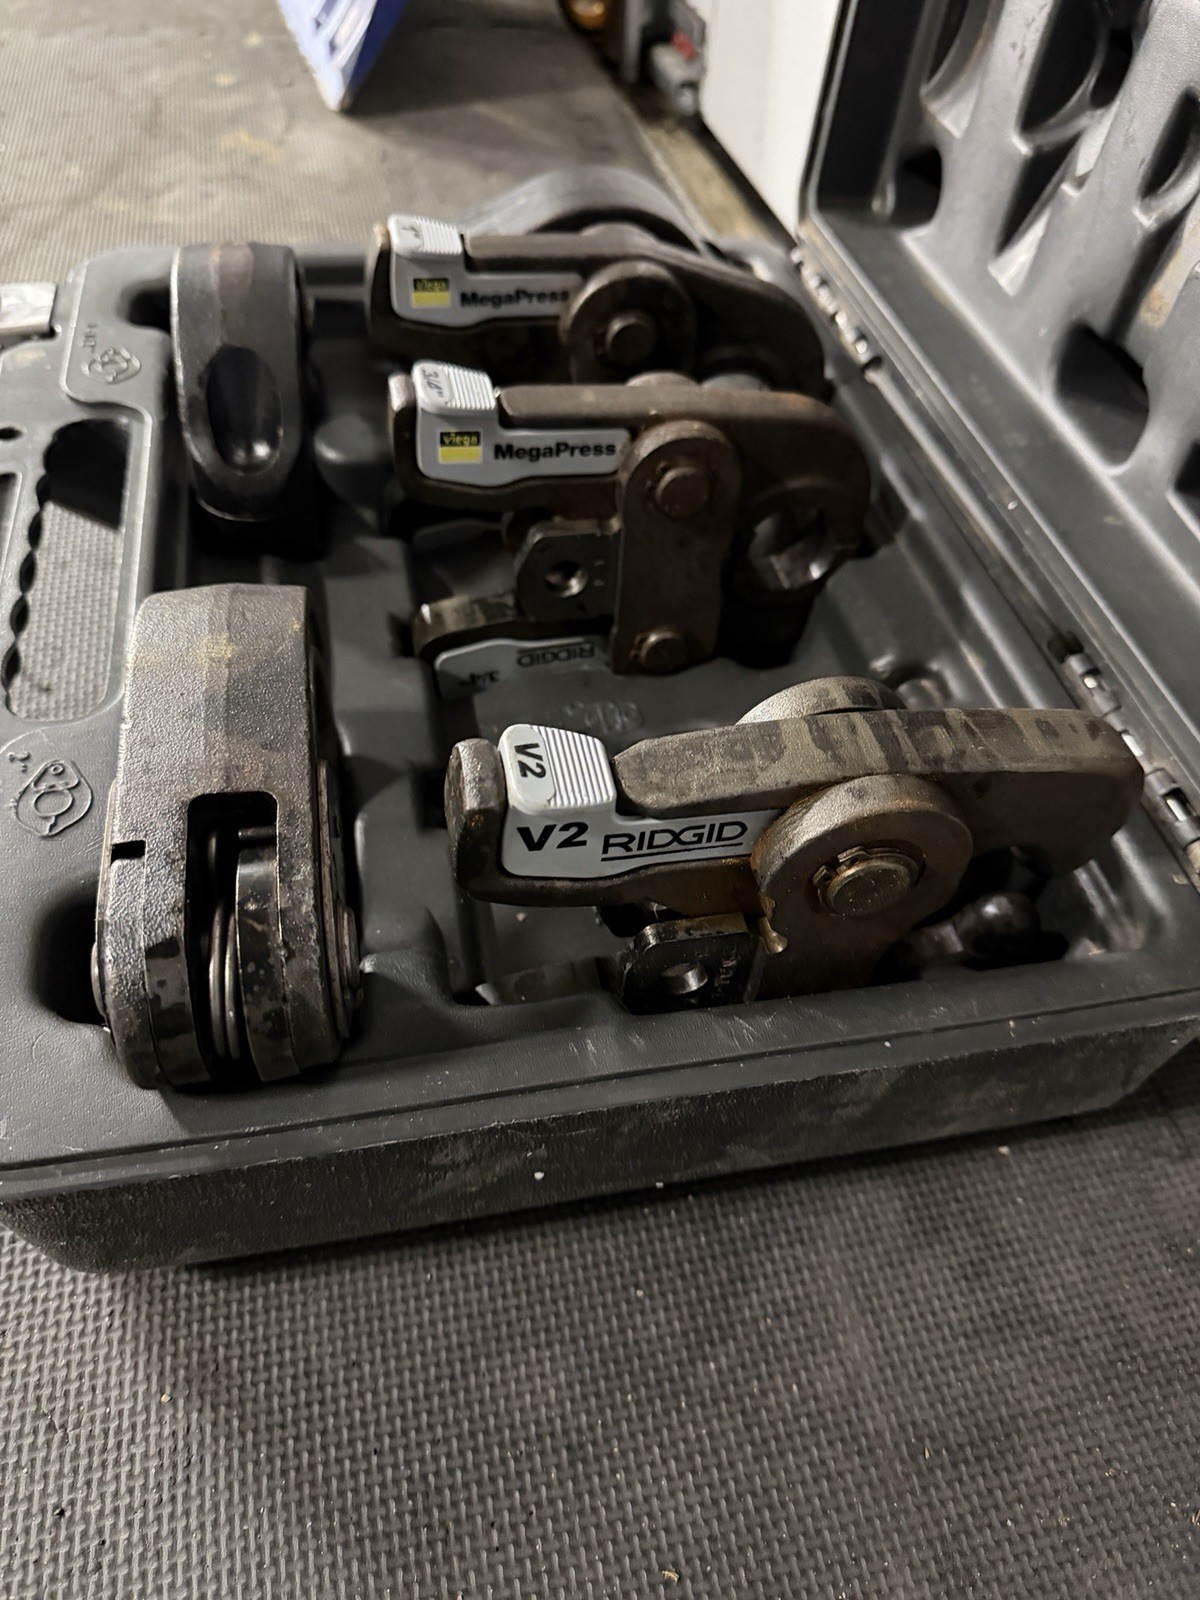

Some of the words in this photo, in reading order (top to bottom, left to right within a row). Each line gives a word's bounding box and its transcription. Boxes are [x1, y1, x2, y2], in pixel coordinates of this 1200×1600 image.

[460, 288, 569, 308] MegaPress
[494, 442, 616, 461] MegaPress
[516, 644, 596, 667] RIDGID
[514, 743, 546, 779] V2
[516, 821, 589, 852] V2
[601, 821, 749, 855] RIDGID
